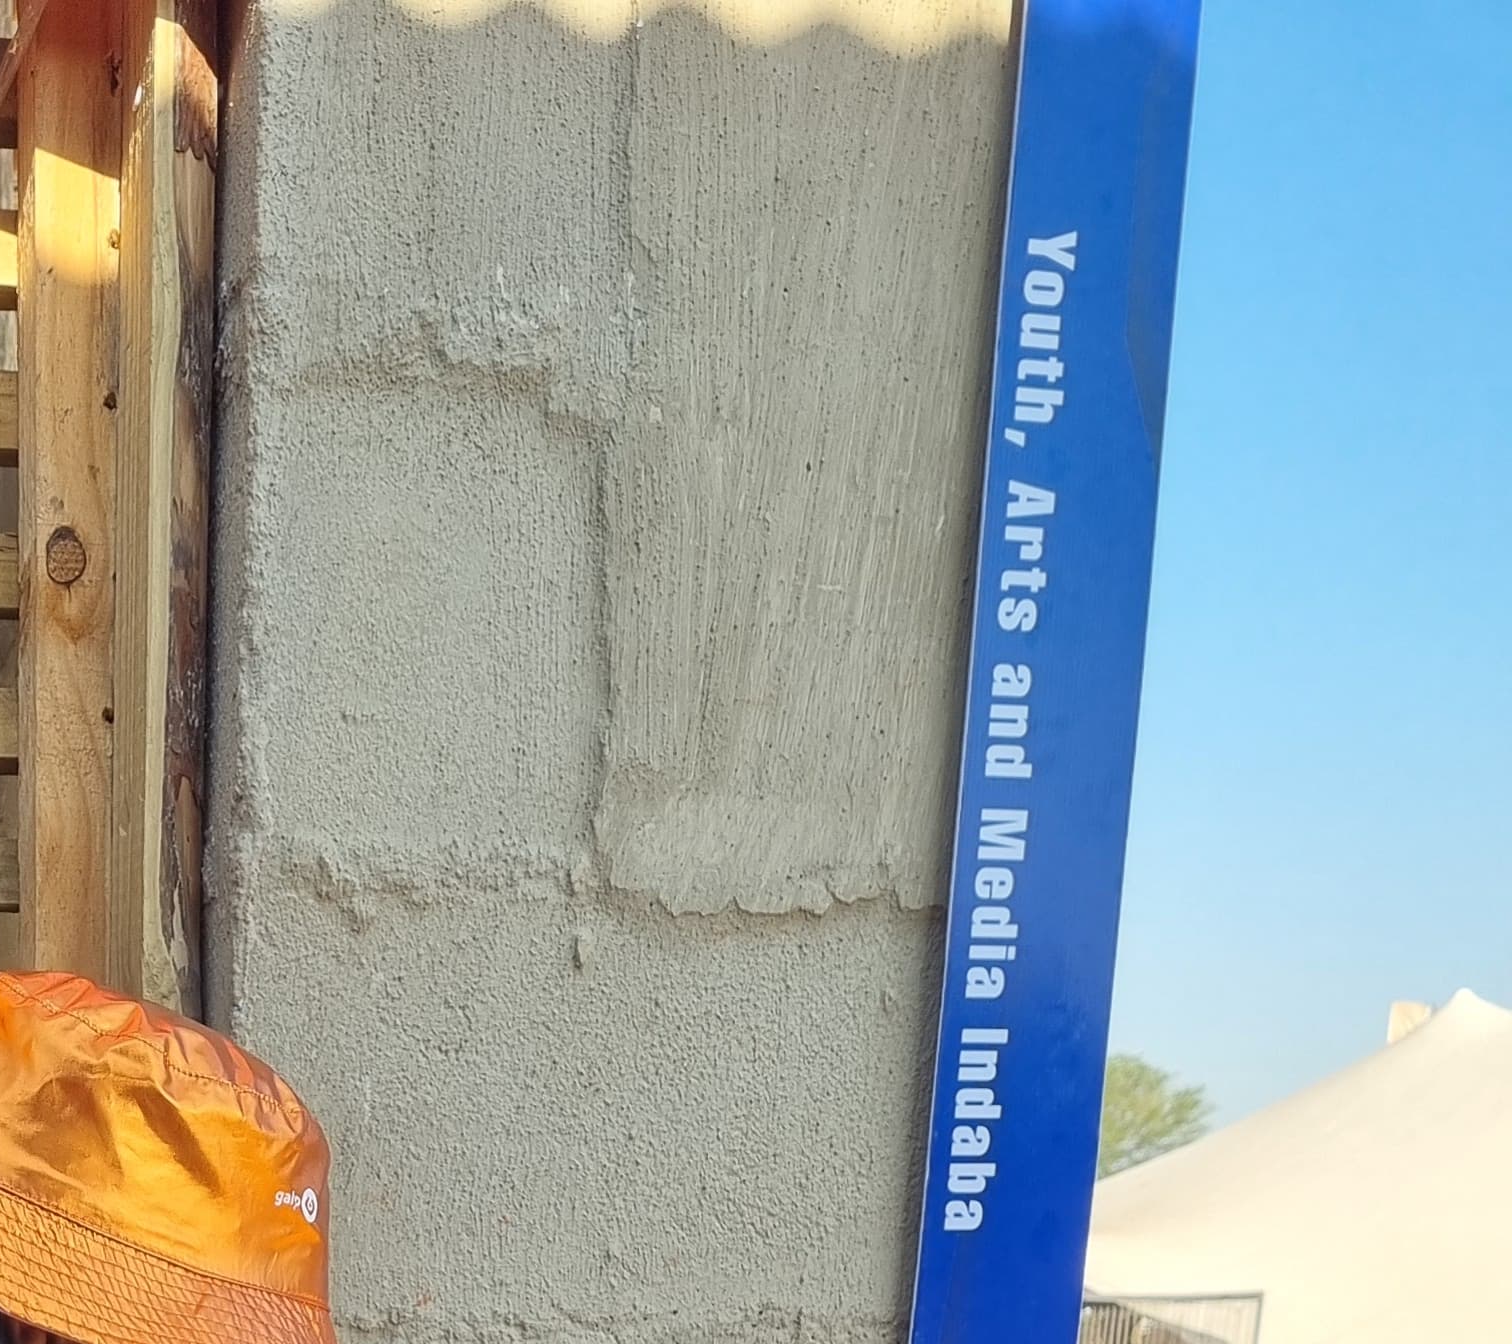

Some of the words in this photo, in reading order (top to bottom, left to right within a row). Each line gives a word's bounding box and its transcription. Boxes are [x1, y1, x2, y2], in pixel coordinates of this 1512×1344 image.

[1004, 231, 1078, 447] Youth,
[997, 480, 1056, 632] Arts
[985, 664, 1032, 778] and
[965, 808, 1029, 999] Media
[274, 1190, 301, 1211] galp
[944, 1028, 1009, 1231] Indaba
